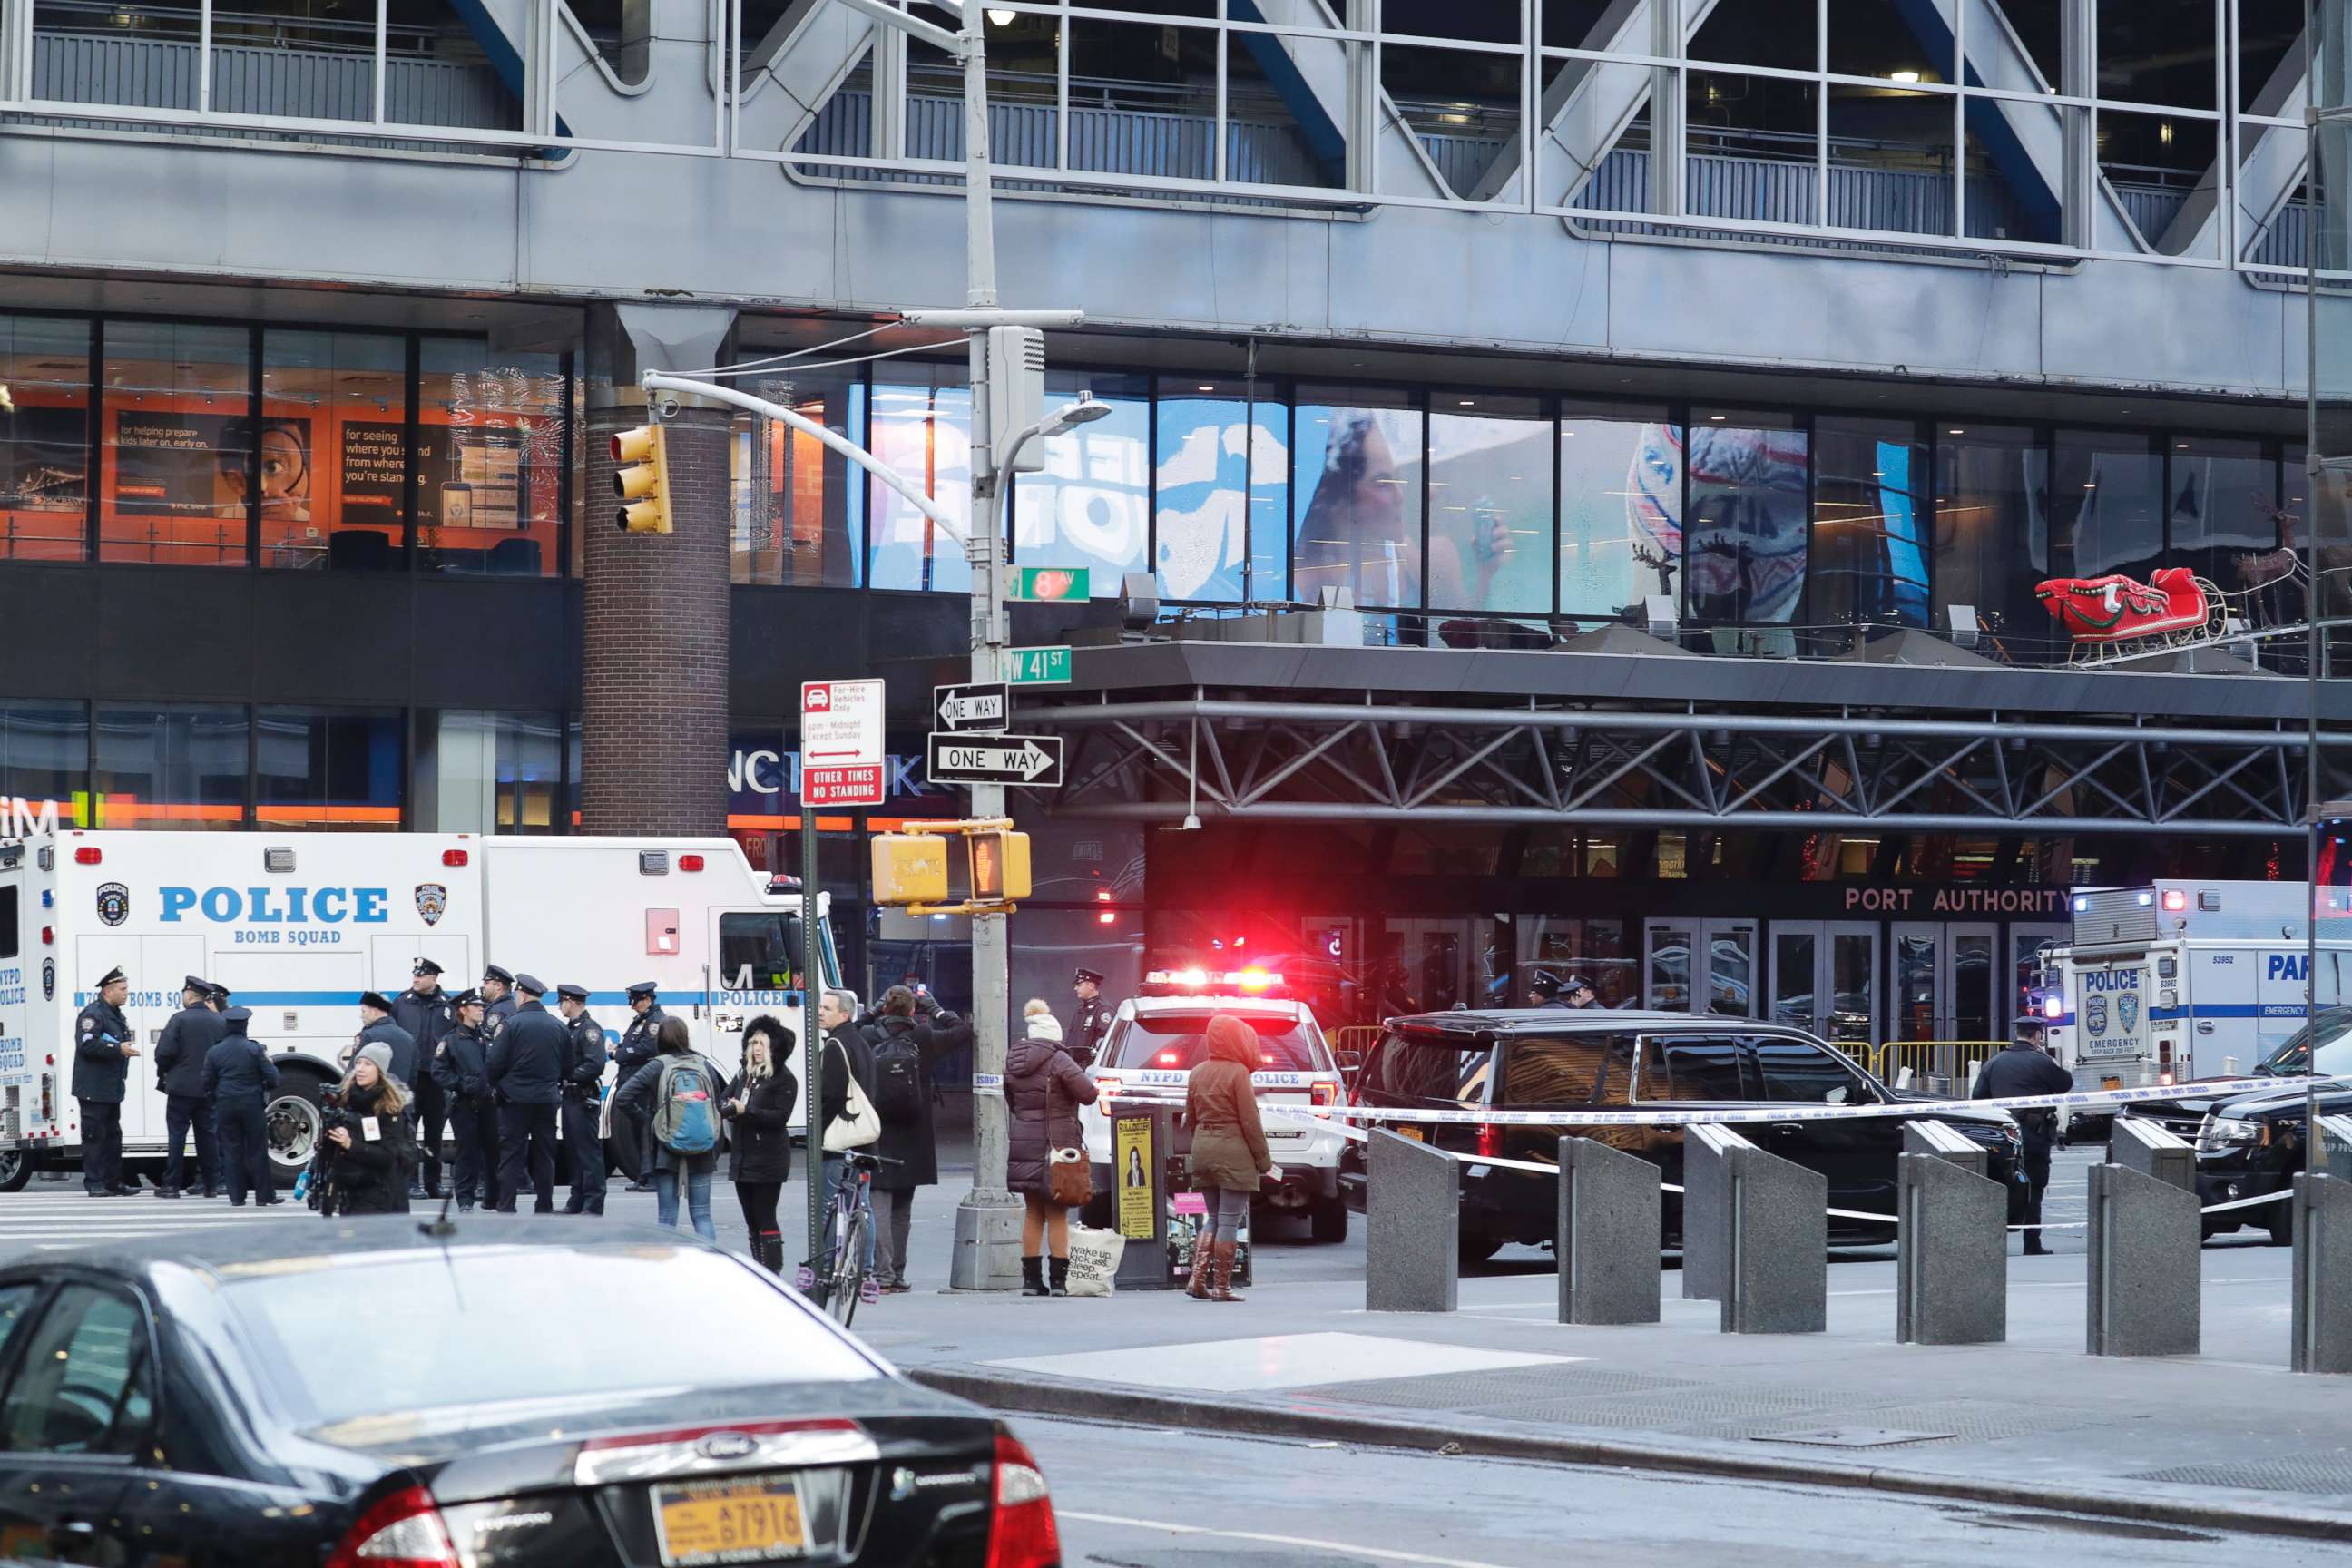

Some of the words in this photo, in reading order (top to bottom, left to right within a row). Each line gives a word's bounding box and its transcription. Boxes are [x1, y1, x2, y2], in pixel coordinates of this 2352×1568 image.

[120, 426, 133, 436] for
[134, 426, 163, 439] helping
[165, 429, 198, 440] prepare
[346, 429, 360, 439] for
[363, 432, 398, 444] seeing
[121, 437, 137, 446] kids
[139, 438, 158, 446] later
[173, 441, 194, 449] early
[346, 444, 378, 455] where
[381, 446, 399, 458] you
[401, 446, 430, 456] snd
[346, 457, 370, 468] from
[373, 459, 406, 469] where
[345, 472, 377, 484] you're
[379, 474, 427, 486] stang.
[1036, 571, 1052, 597] 8
[1059, 572, 1075, 585] AV
[1012, 652, 1024, 681] W
[1030, 652, 1048, 680] 41
[1051, 652, 1063, 666] ST
[833, 695, 866, 703] Vehicles
[834, 704, 851, 712] Only
[946, 701, 965, 719] ONE
[975, 698, 997, 716] WAY
[830, 720, 861, 730] Midnight
[834, 731, 862, 740] Sunday
[949, 750, 986, 768] ONE
[1004, 751, 1041, 769] WAY
[813, 770, 843, 783] OTHER
[848, 769, 874, 782] TIMES
[813, 786, 827, 798] NO
[830, 784, 875, 797] STANDING
[159, 887, 387, 923] POLICE
[1845, 888, 1913, 910] PORT
[1933, 890, 2073, 912] AUTHORITY
[234, 931, 280, 944] BOMB
[288, 930, 341, 946] SQUAD
[2212, 956, 2234, 965] 53952
[2086, 969, 2139, 992] POLICE
[0, 987, 26, 1005] OLICE
[130, 992, 162, 1007] BOMB
[720, 992, 782, 1005] POLICE
[2265, 1007, 2305, 1015] EMERGENCY
[2090, 1038, 2140, 1049] EMERGENCY
[1141, 1073, 1183, 1083] NYPD
[1253, 1073, 1299, 1084] OLICE
[1070, 1252, 1091, 1263] kick
[1071, 1246, 1098, 1257] wake
[1069, 1261, 1096, 1273] sleep.
